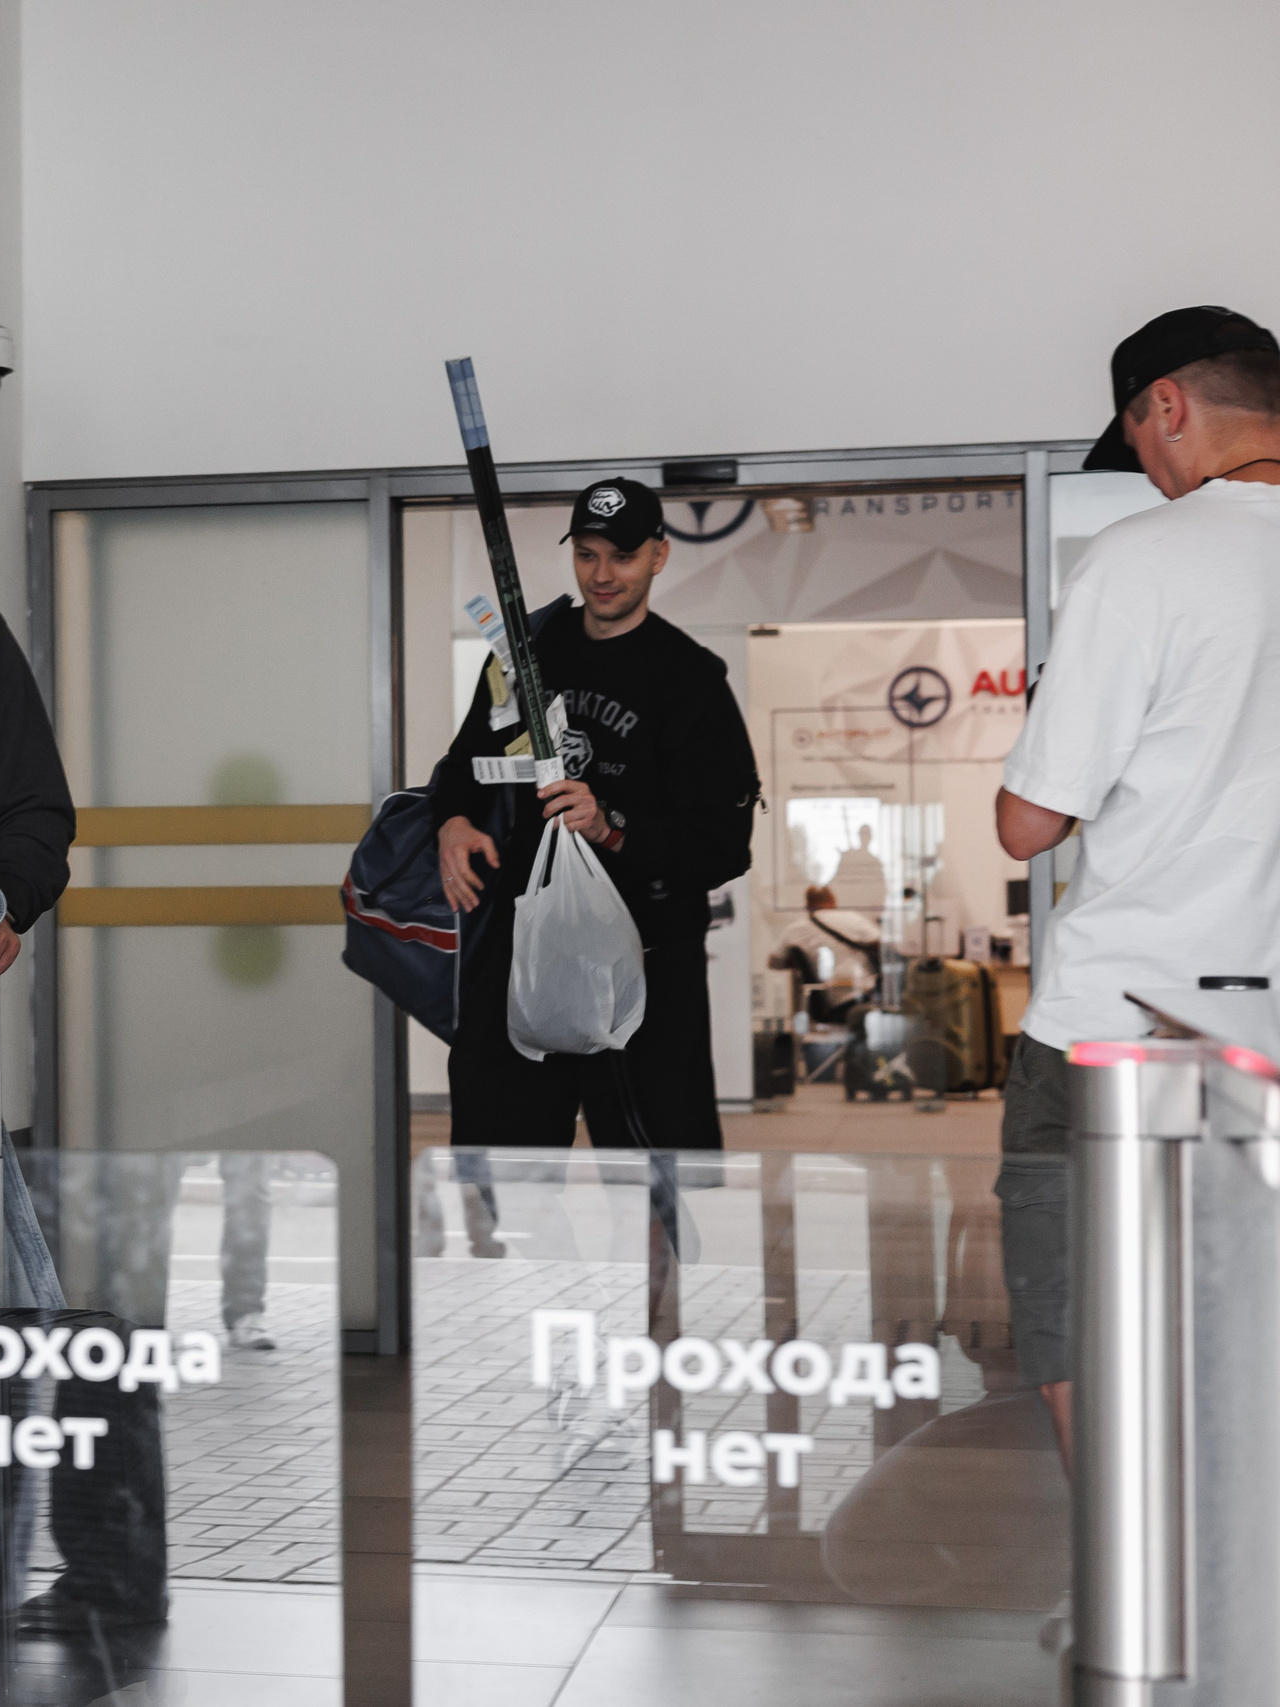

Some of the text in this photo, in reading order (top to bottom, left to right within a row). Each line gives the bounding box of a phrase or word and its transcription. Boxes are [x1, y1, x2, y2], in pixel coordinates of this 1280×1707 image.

[812, 490, 1018, 516] RANSPORT
[542, 688, 639, 738] AKTOR
[532, 1308, 942, 1409] Прохода
[652, 1428, 814, 1488] нет
